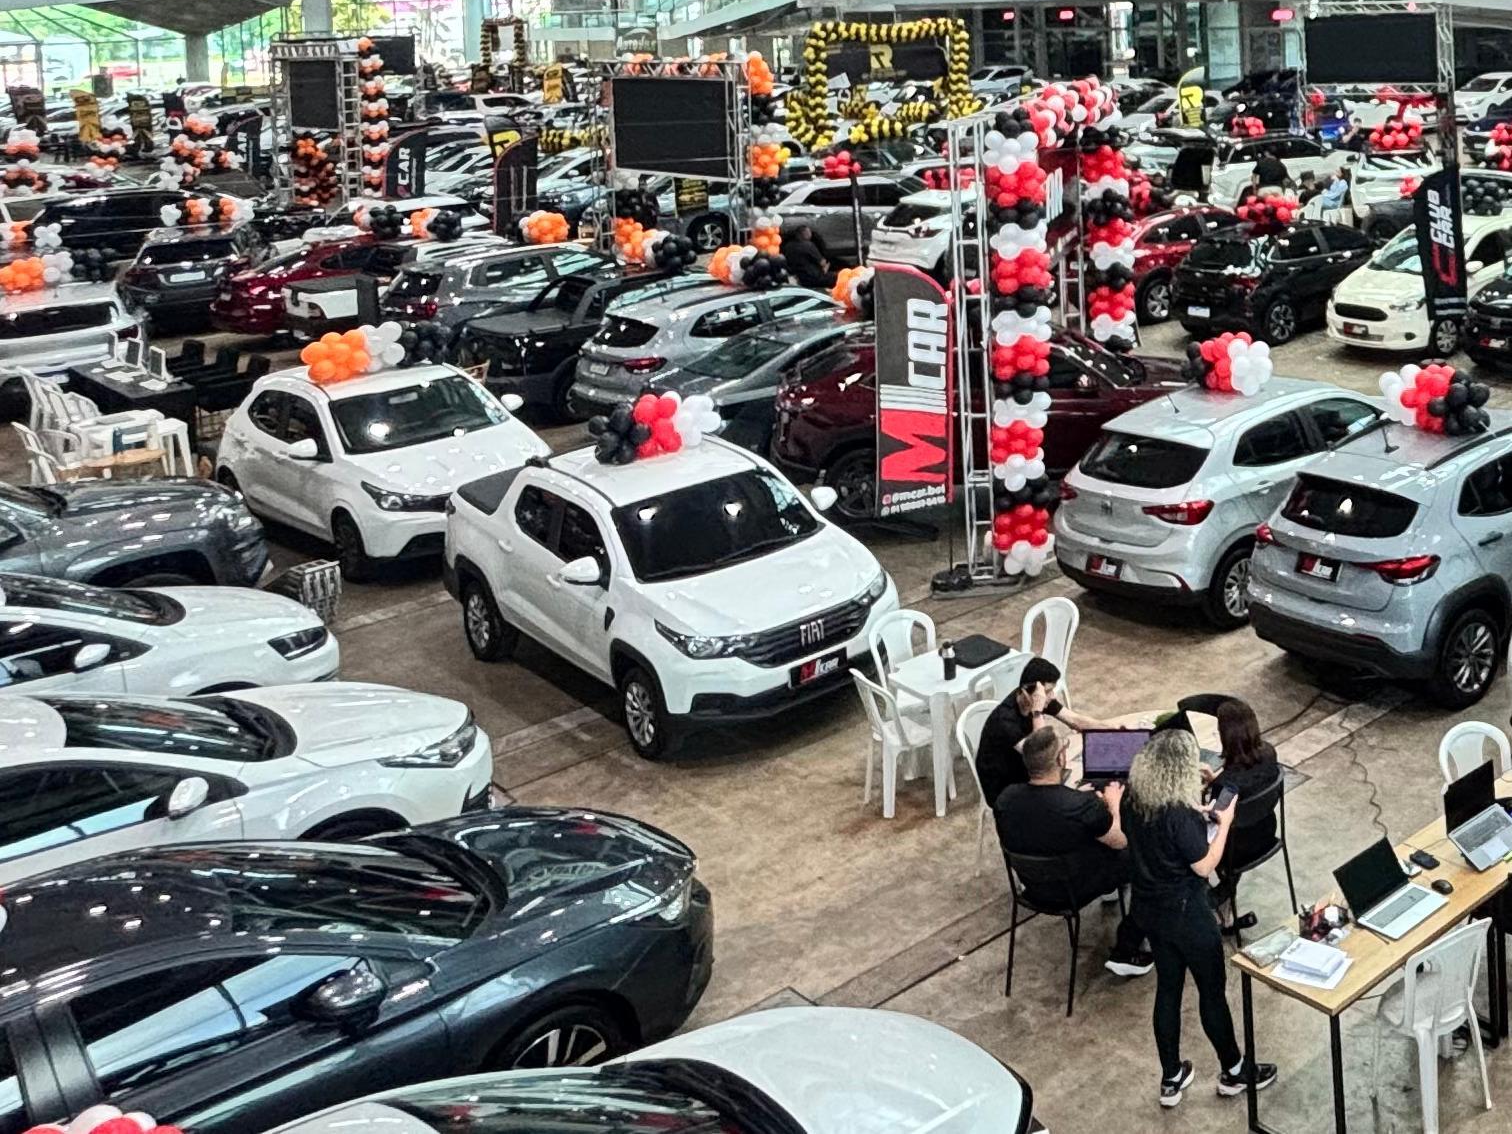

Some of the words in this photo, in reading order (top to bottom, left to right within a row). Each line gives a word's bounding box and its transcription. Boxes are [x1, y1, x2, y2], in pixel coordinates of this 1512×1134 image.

[398, 148, 410, 185] CAR
[1427, 189, 1441, 244] CLUB
[1440, 206, 1455, 249] CAR
[800, 619, 824, 646] FIAT
